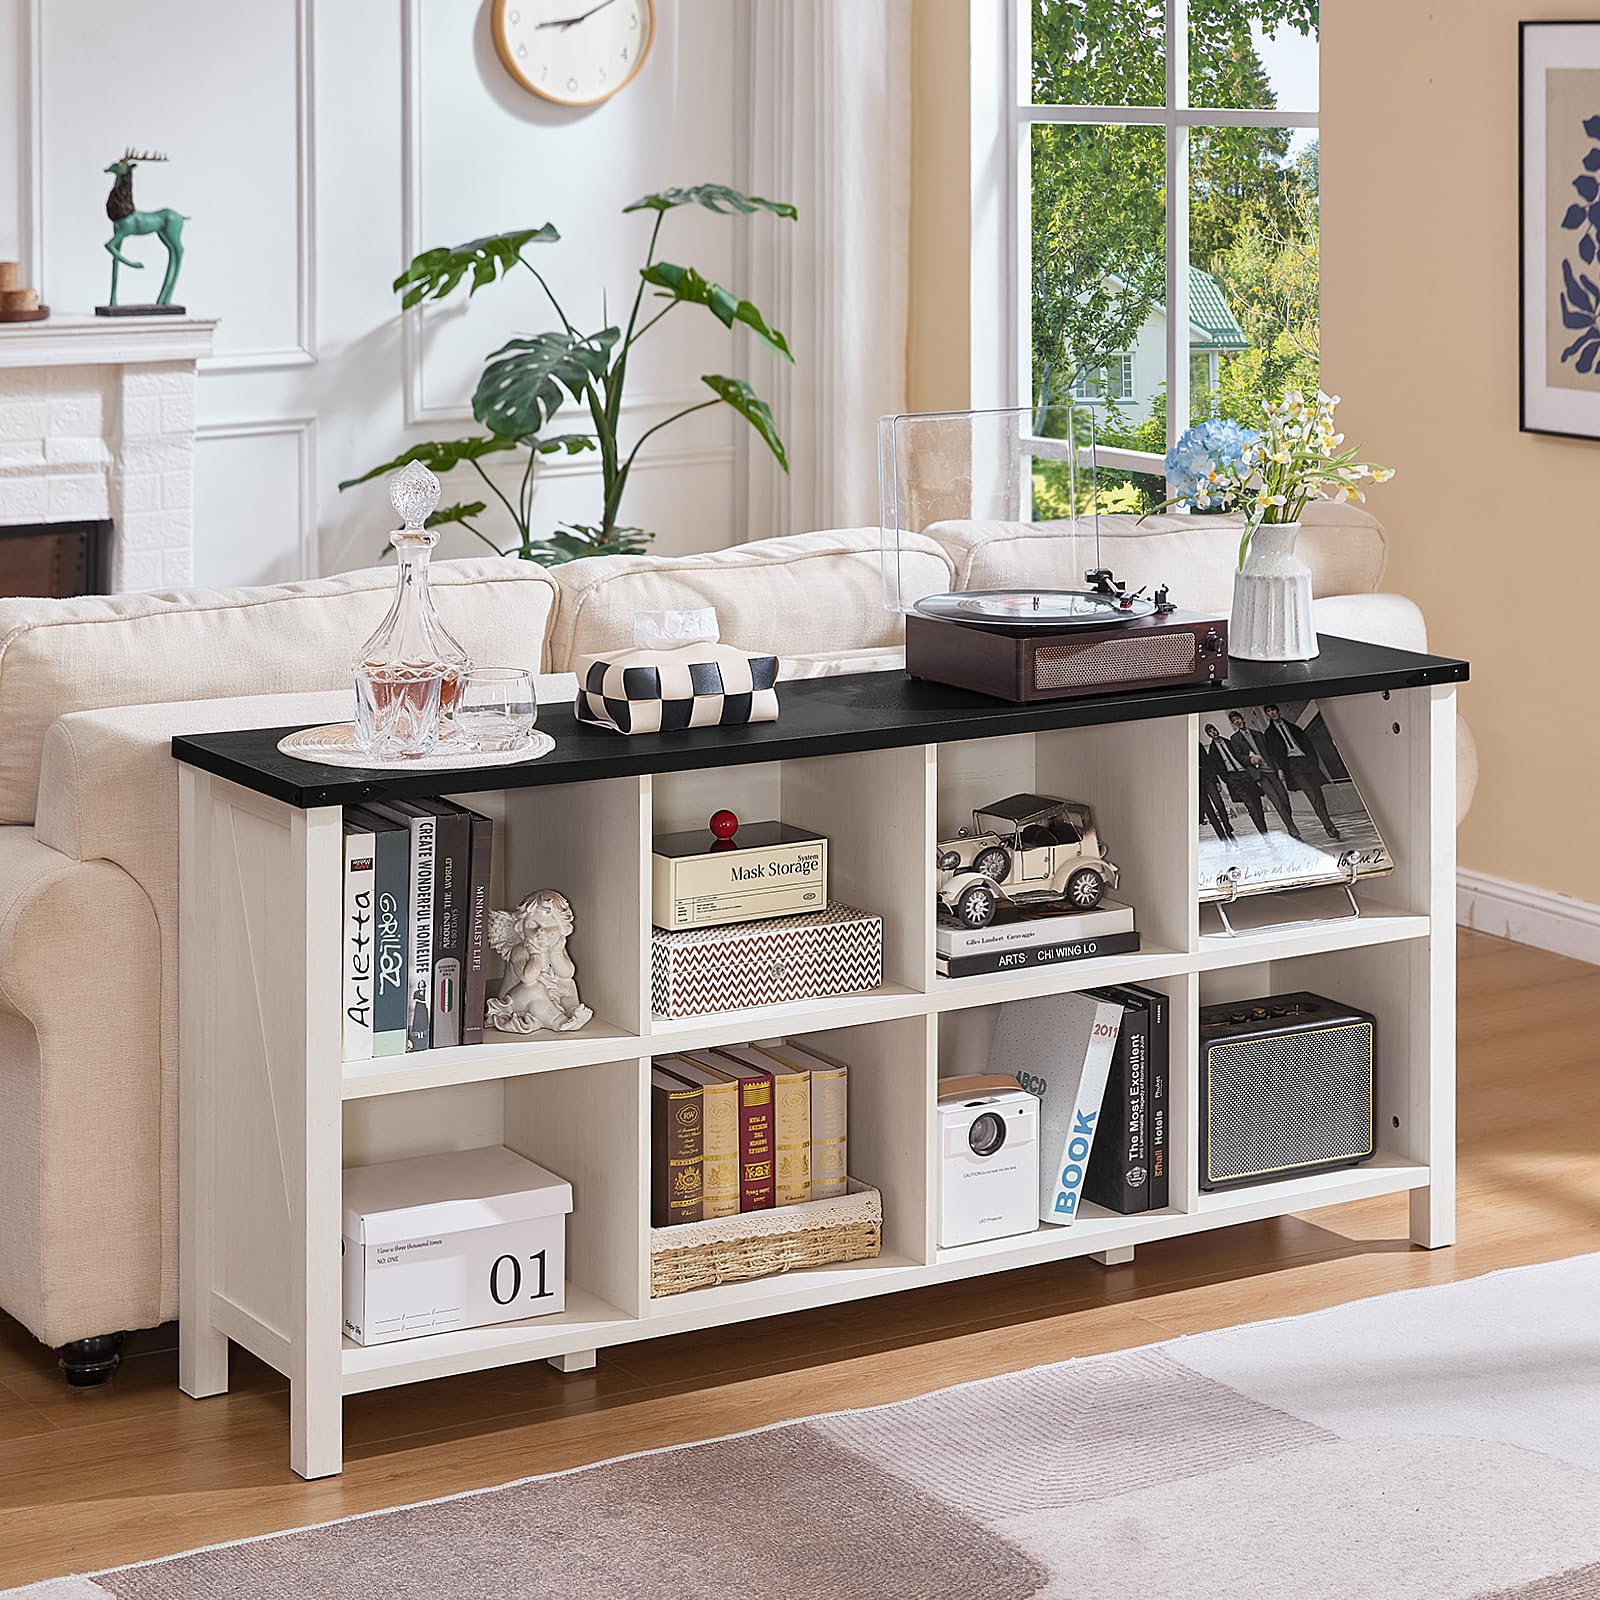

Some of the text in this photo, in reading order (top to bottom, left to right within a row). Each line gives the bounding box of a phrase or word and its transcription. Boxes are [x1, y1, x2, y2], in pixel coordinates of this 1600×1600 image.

[731, 860, 819, 881] Mask Storage
[797, 854, 819, 863] System
[416, 822, 434, 974] CREATE WONDERFUL HOMELIFE
[443, 857, 453, 949] AROUND THE WORLD
[473, 886, 485, 972] MINIMALIST LIFE
[347, 889, 371, 1028] Arletta
[1037, 950, 1054, 961] CHI
[1056, 944, 1082, 958] WING
[1083, 942, 1097, 954] LO
[1093, 1023, 1118, 1038] 2011
[1129, 1033, 1140, 1097] Excellent
[1129, 1098, 1140, 1132] Most
[1154, 1110, 1163, 1145] Hotels
[1054, 1108, 1098, 1215] BOOK
[1128, 1135, 1139, 1162] The
[1154, 1150, 1163, 1177] small
[490, 1248, 554, 1305] 01
